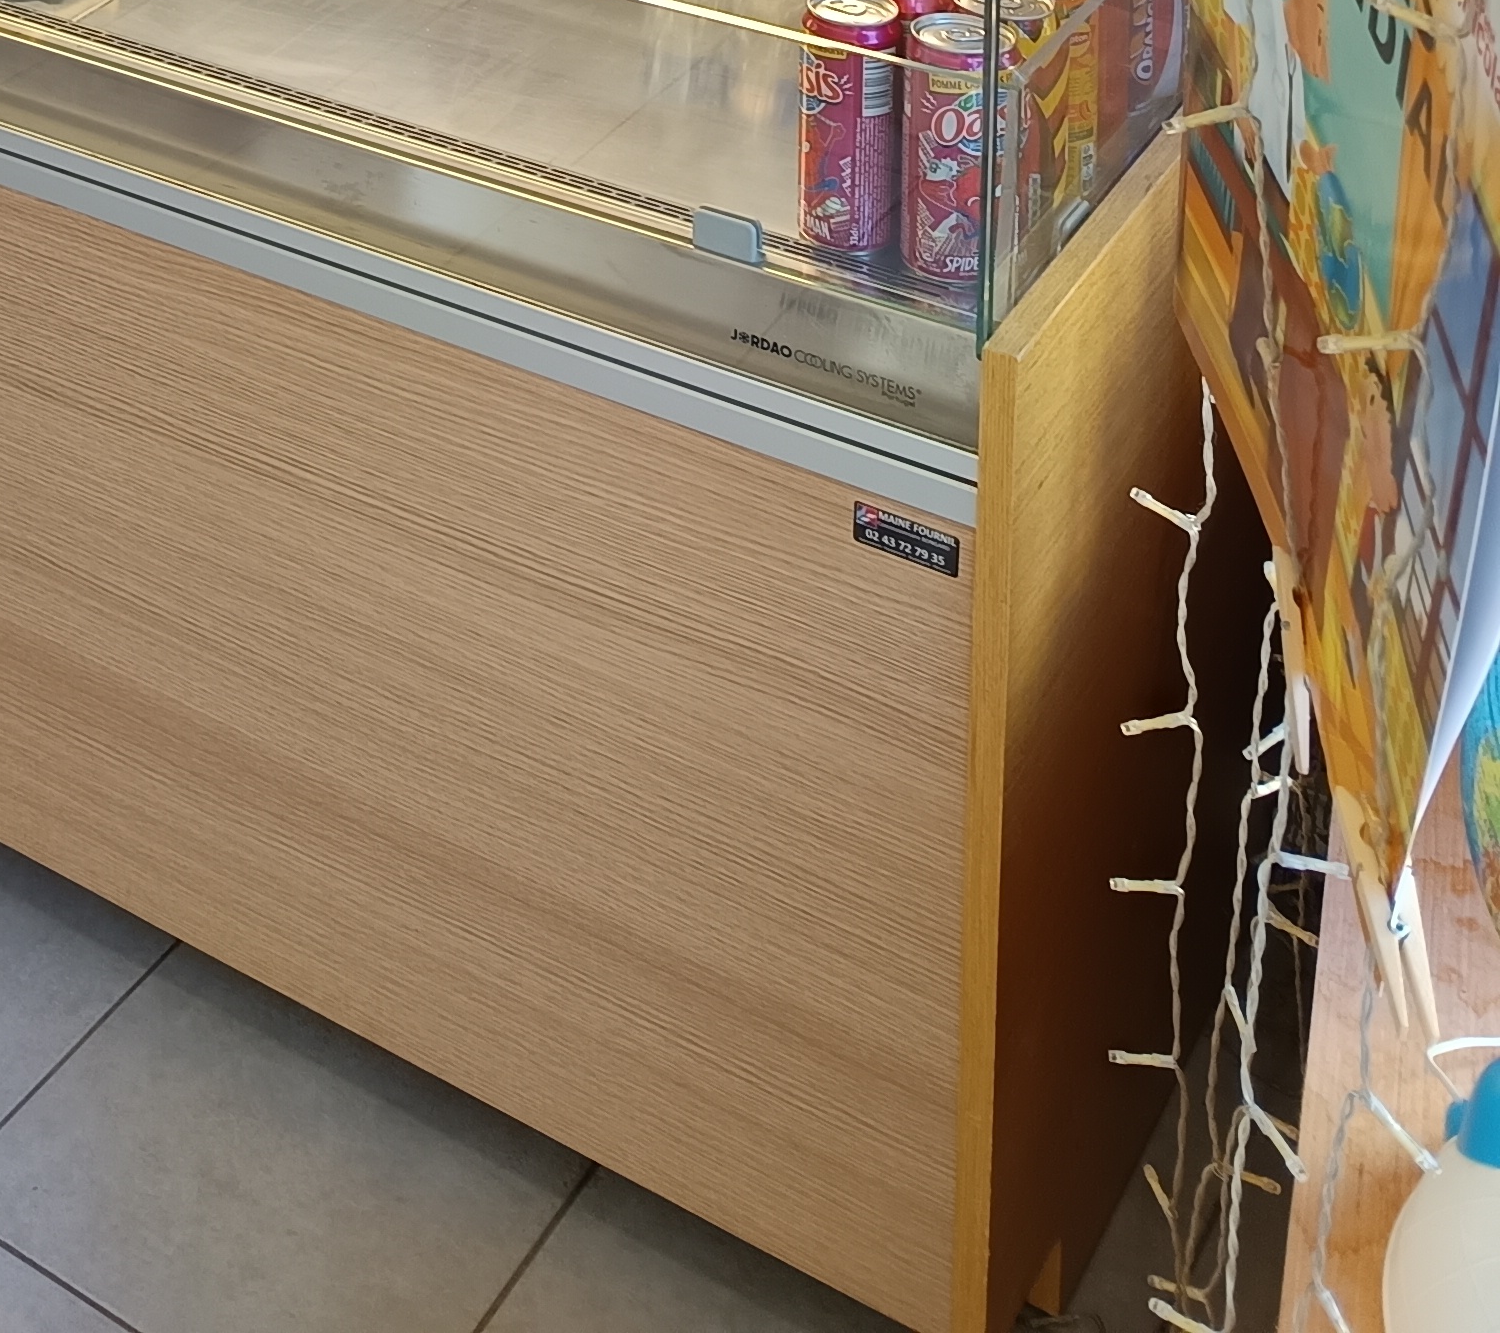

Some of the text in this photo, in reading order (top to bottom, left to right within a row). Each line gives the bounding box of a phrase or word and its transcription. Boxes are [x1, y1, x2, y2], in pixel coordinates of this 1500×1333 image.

[942, 256, 979, 274] SPIDE
[794, 349, 853, 380] COOLING
[879, 511, 912, 531] MAINE
[913, 523, 957, 548] FOURNIL
[865, 528, 880, 542] 02
[881, 535, 896, 548] 43
[898, 540, 912, 554] 72
[913, 546, 928, 559] 79
[930, 552, 945, 566] 35
